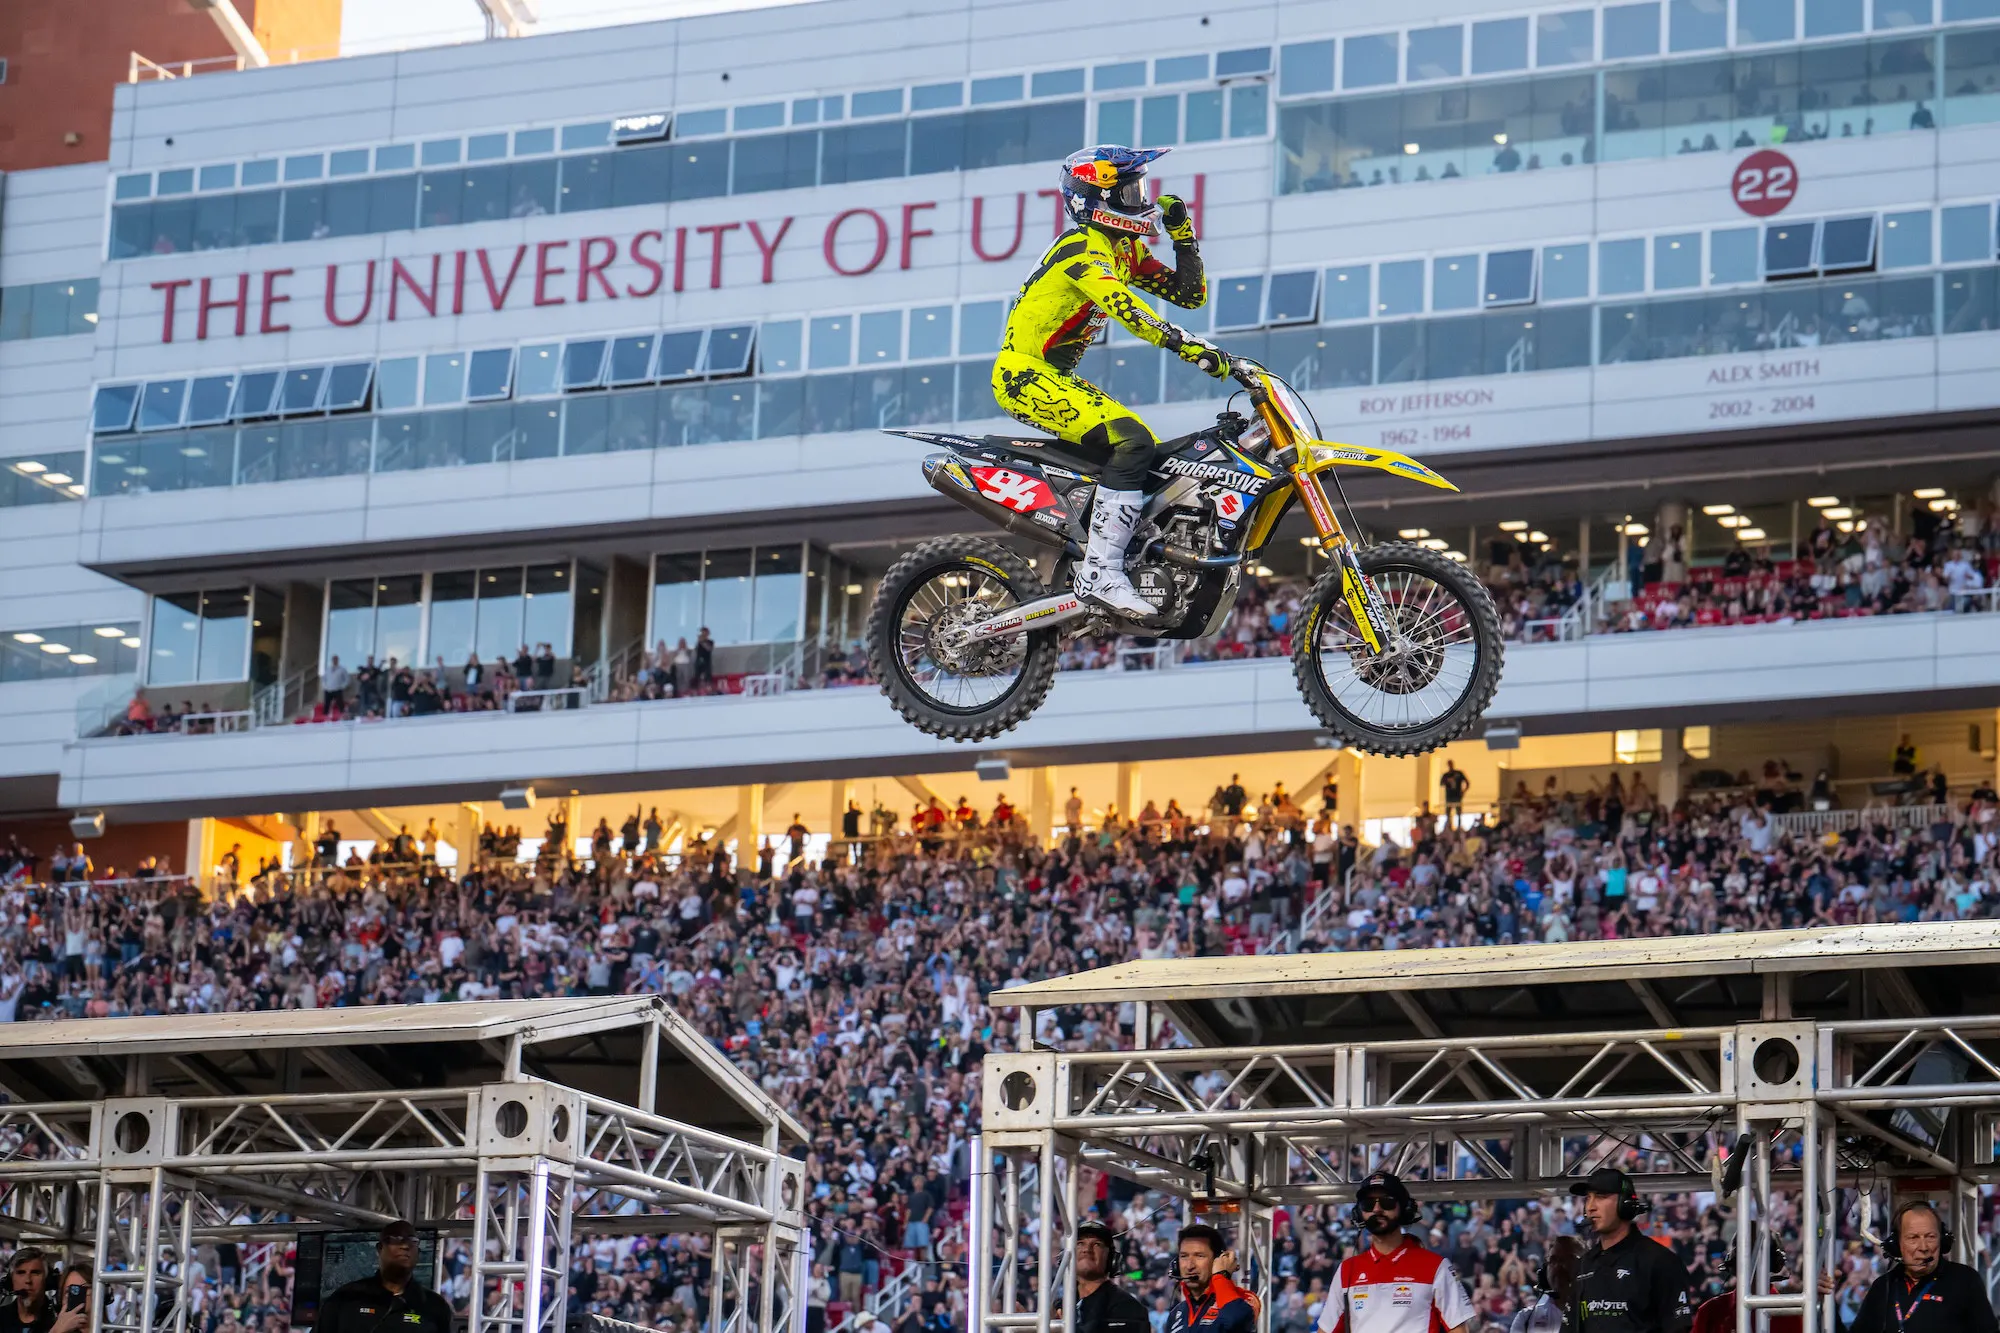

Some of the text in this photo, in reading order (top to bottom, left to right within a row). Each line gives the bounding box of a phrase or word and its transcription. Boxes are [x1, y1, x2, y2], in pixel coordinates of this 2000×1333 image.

[1737, 165, 1794, 202] 22
[1093, 209, 1151, 234] Red Bull
[150, 173, 1206, 343] THE UNIVERSITY OF UTH
[1707, 360, 1820, 385] ALEX SMITH
[1359, 388, 1495, 415] ROY JEFFERSON
[1708, 400, 1753, 420] 2002
[1769, 395, 1816, 415] 2004
[939, 436, 979, 448] DUNLOP
[1380, 428, 1419, 446] 1962
[1432, 424, 1472, 442] 1964
[1315, 449, 1369, 461] PRGRESSIVE
[1045, 466, 1068, 476] SUZUKI
[1159, 456, 1267, 496] PROGRESSIVE
[981, 469, 1041, 512] 94
[1137, 587, 1167, 596] UZUKI
[1347, 567, 1369, 605] ACERBIS
[1304, 603, 1321, 655] DUNLOP
